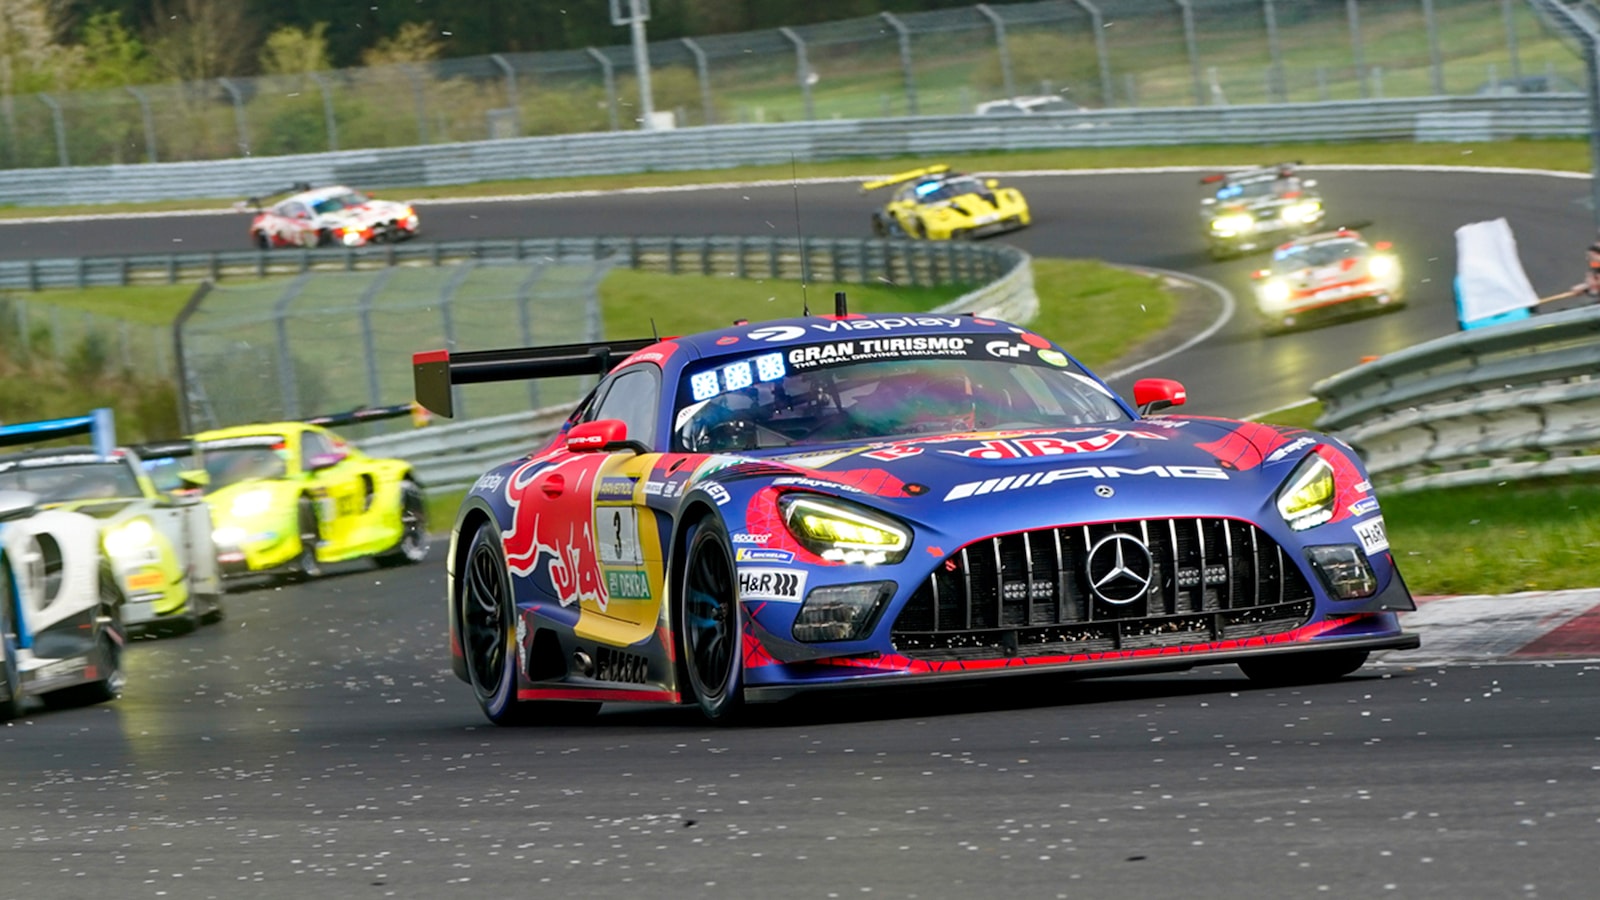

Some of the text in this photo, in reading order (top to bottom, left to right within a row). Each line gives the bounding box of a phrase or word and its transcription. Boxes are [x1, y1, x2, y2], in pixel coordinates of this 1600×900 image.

[811, 316, 961, 333] viaplay
[788, 344, 854, 364] GRAN
[985, 340, 1031, 358] GT
[793, 361, 818, 369] THE
[821, 356, 850, 365] REAL
[852, 352, 900, 360] DRIVING
[1036, 465, 1230, 481] AMG
[613, 511, 622, 559] 3
[732, 533, 768, 544] sparco
[619, 573, 650, 597] DEKRA
[739, 572, 772, 592] H&R
